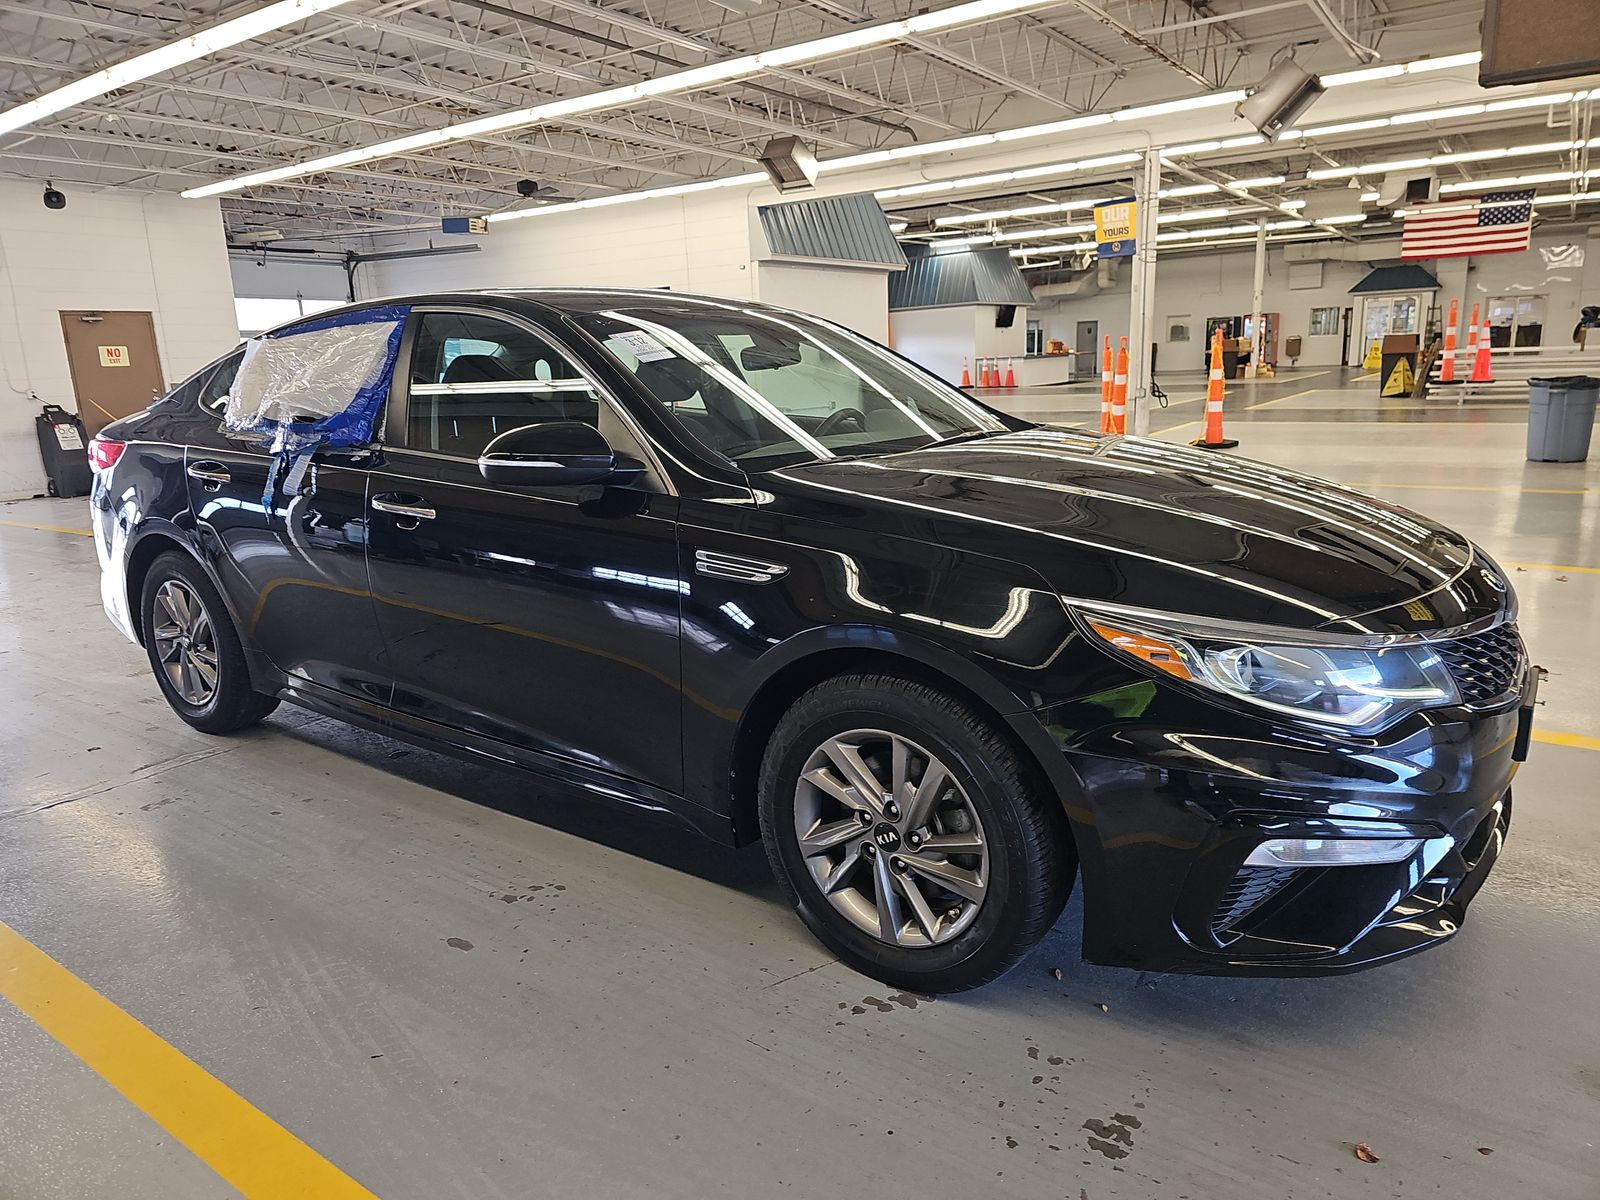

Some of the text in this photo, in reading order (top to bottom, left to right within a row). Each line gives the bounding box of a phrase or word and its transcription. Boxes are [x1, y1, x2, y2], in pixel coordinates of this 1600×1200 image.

[1102, 205, 1130, 222] OUR
[1103, 226, 1130, 238] YOURS
[106, 348, 121, 358] NO
[876, 831, 898, 845] KIA
